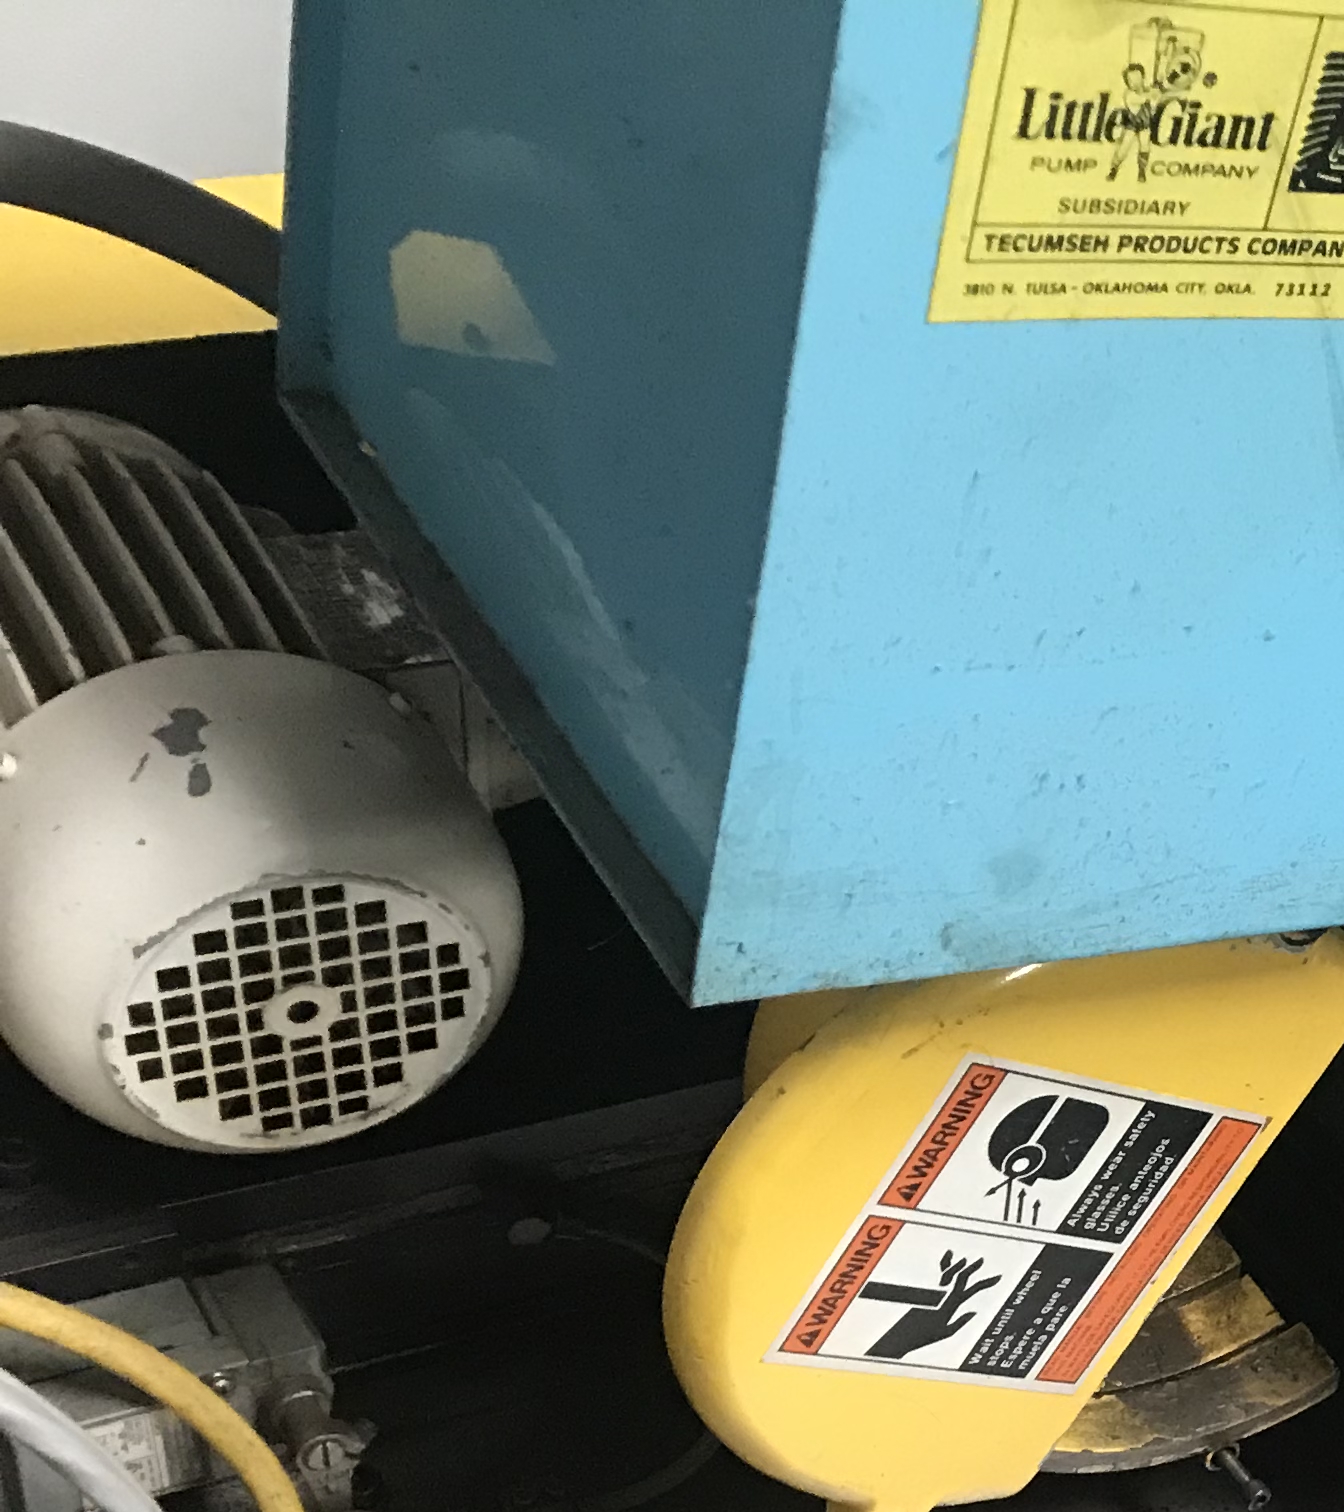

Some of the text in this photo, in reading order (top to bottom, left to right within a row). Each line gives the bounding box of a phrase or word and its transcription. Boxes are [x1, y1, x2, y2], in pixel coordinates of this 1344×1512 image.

[1015, 87, 1277, 151] Little Giant
[1030, 156, 1259, 181] PUMP COMPANY
[1057, 198, 1190, 217] SUBSIDIARY
[983, 234, 1110, 255] TECUMSEH
[1117, 235, 1239, 257] PRODUCTS
[1082, 281, 1169, 297] OKLAHOMA
[1274, 282, 1331, 299] 73112
[906, 1073, 996, 1181] WARNING
[1067, 1110, 1155, 1227] Always wear safety
[1097, 1138, 1170, 1232] Utilice anteojos
[1084, 1183, 1122, 1229] glasses.
[1115, 1220, 1130, 1234] de
[805, 1224, 892, 1332] WARNING
[968, 1270, 1041, 1364] Wait until wheel
[1001, 1277, 1071, 1368] Espere a que la
[1018, 1335, 1047, 1370] muela
